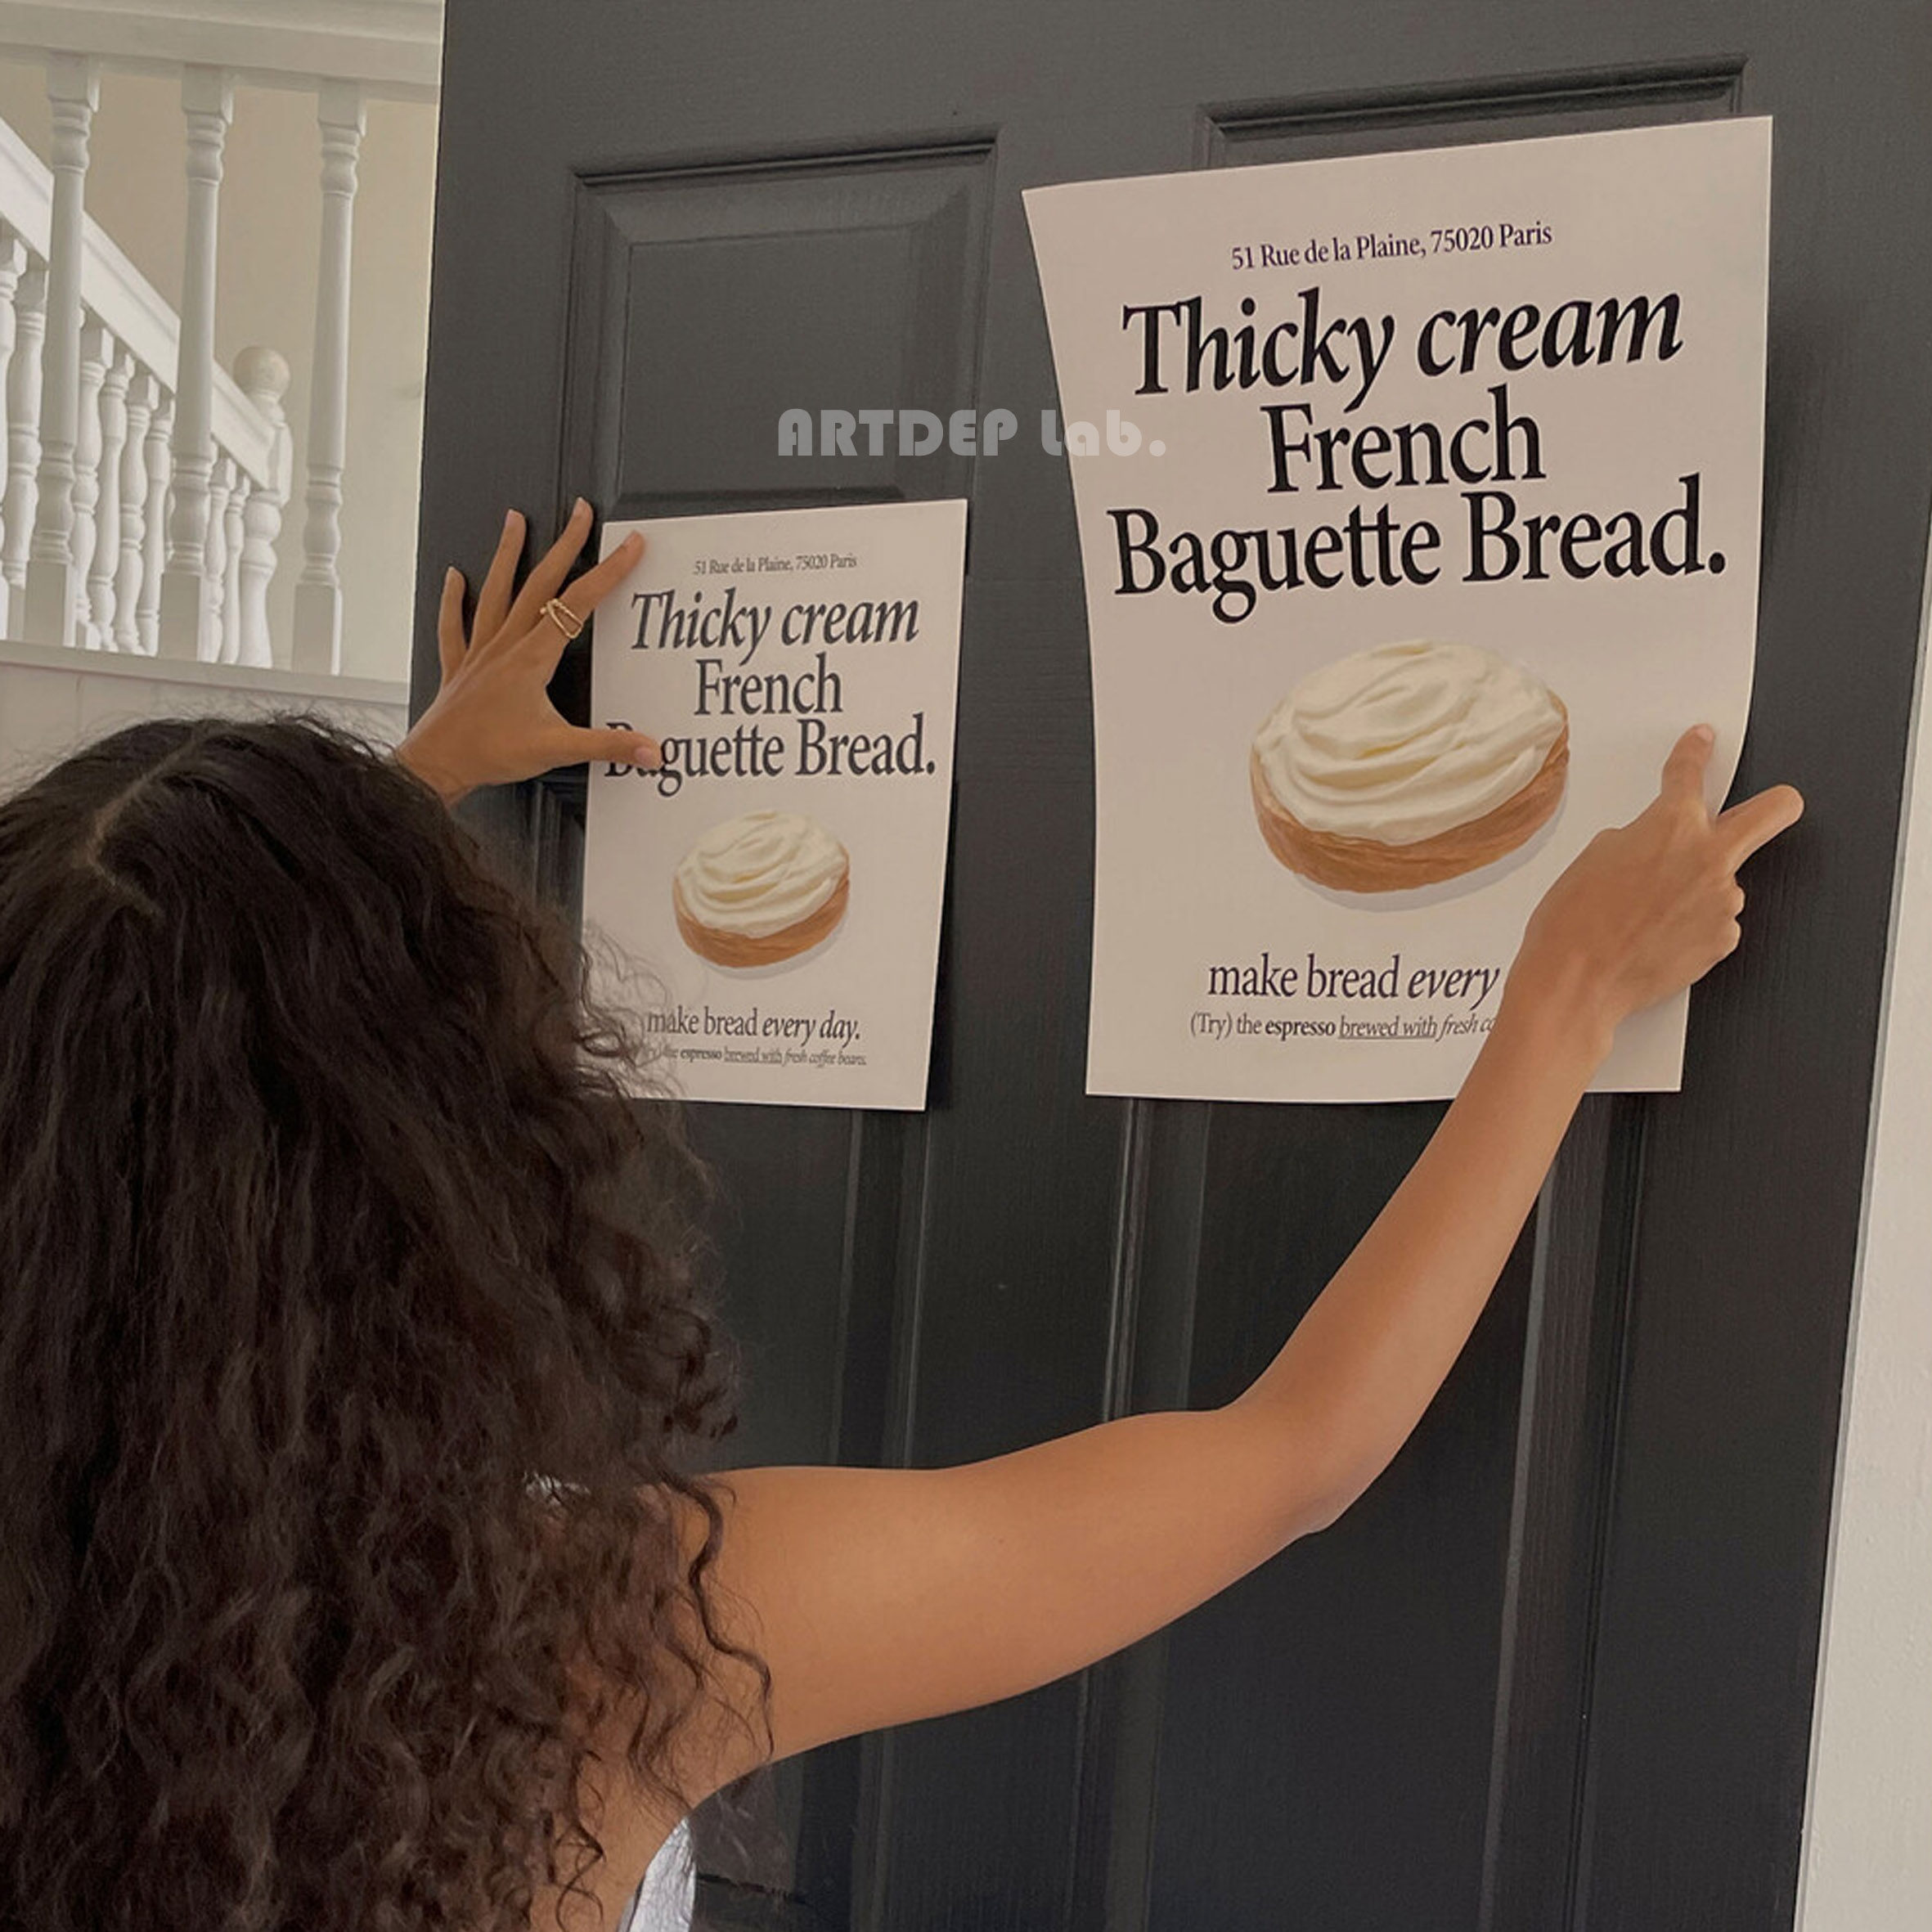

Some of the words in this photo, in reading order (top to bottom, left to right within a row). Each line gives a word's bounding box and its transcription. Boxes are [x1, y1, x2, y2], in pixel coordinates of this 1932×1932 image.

[1231, 247, 1255, 270] 51
[1260, 243, 1301, 268] Rue
[1305, 237, 1330, 264] de
[1333, 236, 1352, 262] la
[1356, 232, 1427, 259] Plaine,
[1430, 227, 1495, 254] 75020
[1498, 221, 1553, 249] Paris
[1123, 287, 1395, 413] Thicky
[1416, 290, 1683, 376] cream
[1260, 384, 1546, 494] French
[694, 559, 706, 574] 51
[709, 557, 729, 574] Rue
[731, 556, 744, 573] de
[796, 554, 829, 571] 75020
[830, 552, 858, 569] Paris
[1107, 503, 1441, 624] Baguette
[1460, 473, 1728, 583] Bread.
[631, 586, 772, 667] Thicky
[781, 599, 919, 645] cream
[694, 651, 843, 716] French
[795, 712, 936, 777] Bread.
[1207, 952, 1298, 997] make
[1307, 953, 1400, 999] bread
[1407, 967, 1501, 1011] every
[647, 1004, 699, 1034] make
[703, 1005, 757, 1036] bread
[762, 1017, 815, 1047] every
[820, 1009, 860, 1049] day.
[1190, 1012, 1233, 1040] (Try)
[1237, 1013, 1262, 1035] the
[1265, 1020, 1336, 1041] espresso
[1337, 1014, 1400, 1040] brewed
[1403, 1016, 1437, 1039] with
[1435, 1014, 1479, 1043] fresh
